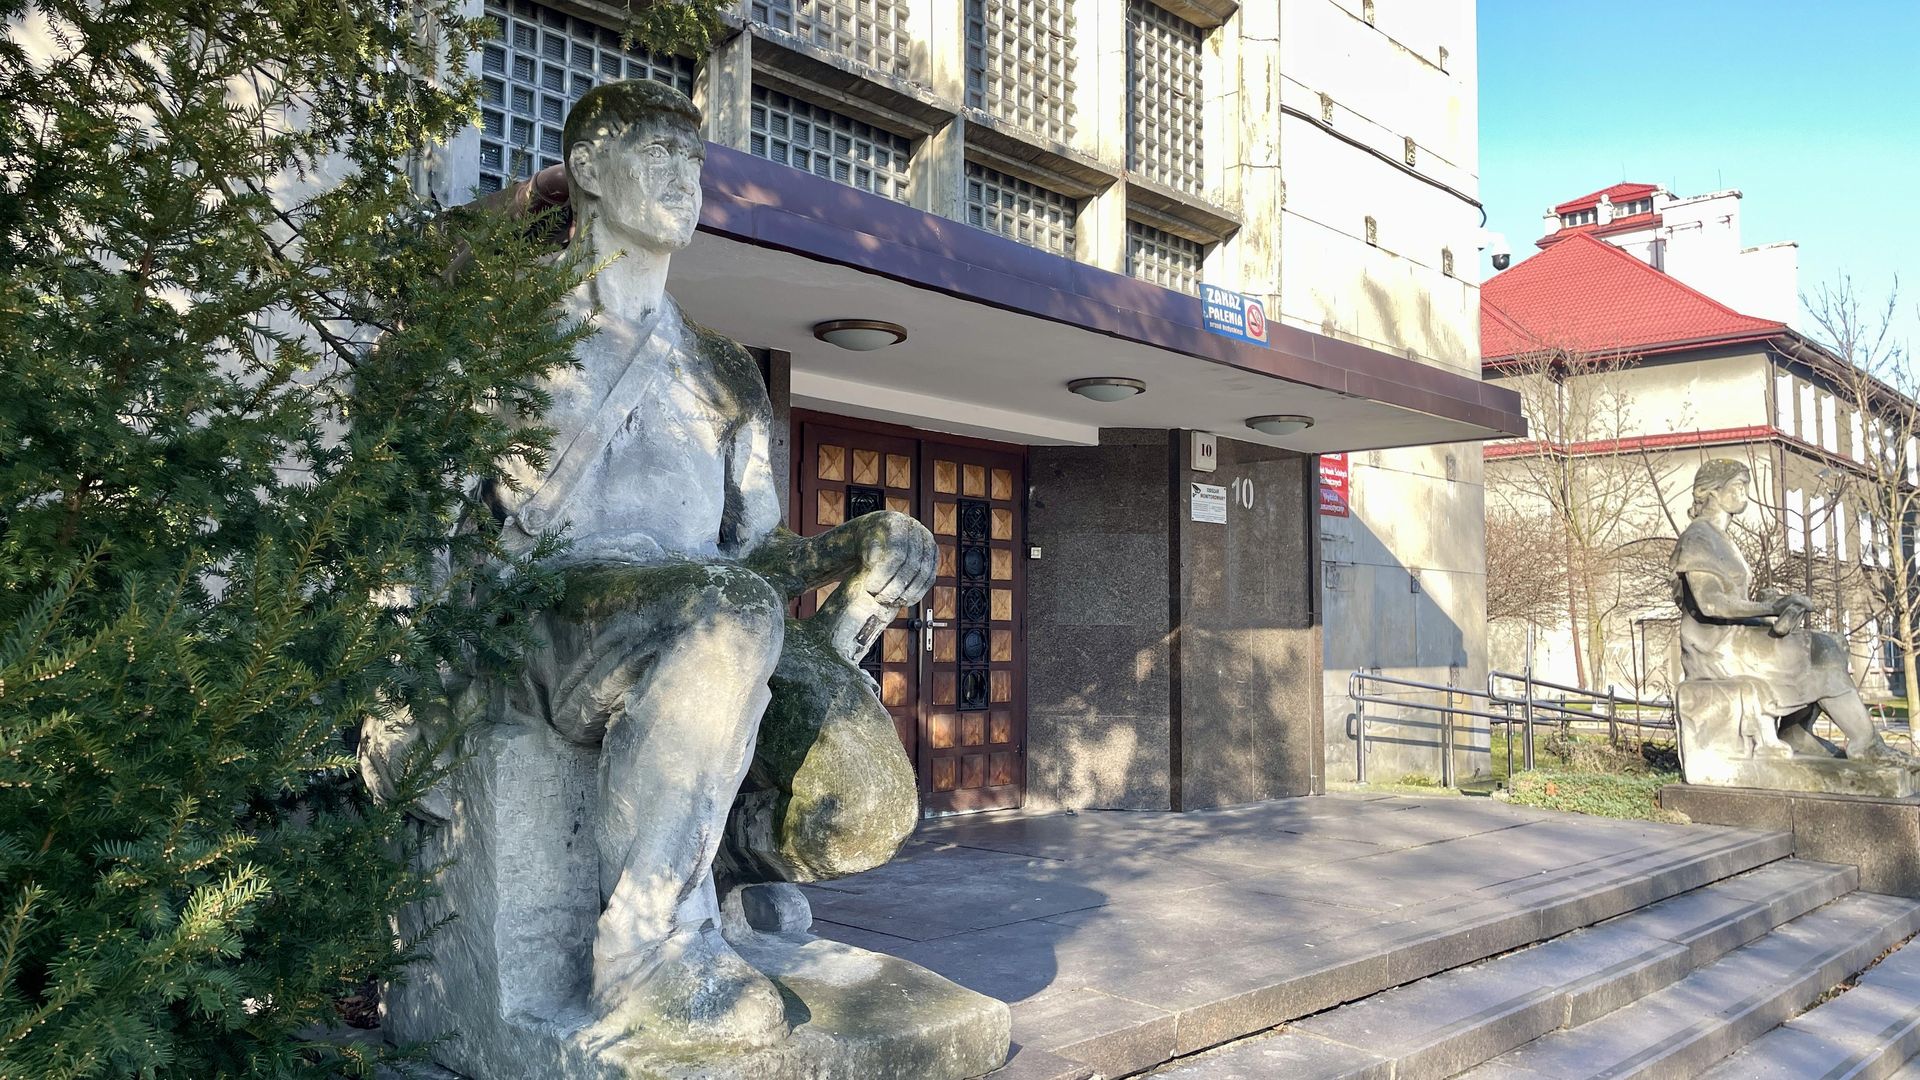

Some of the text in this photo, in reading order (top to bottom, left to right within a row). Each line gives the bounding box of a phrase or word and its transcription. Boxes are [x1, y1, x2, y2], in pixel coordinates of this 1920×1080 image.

[1206, 287, 1241, 311] ZAKAZ
[1208, 306, 1243, 327] PALENIA
[1201, 443, 1212, 458] 10
[1231, 476, 1254, 510] 10
